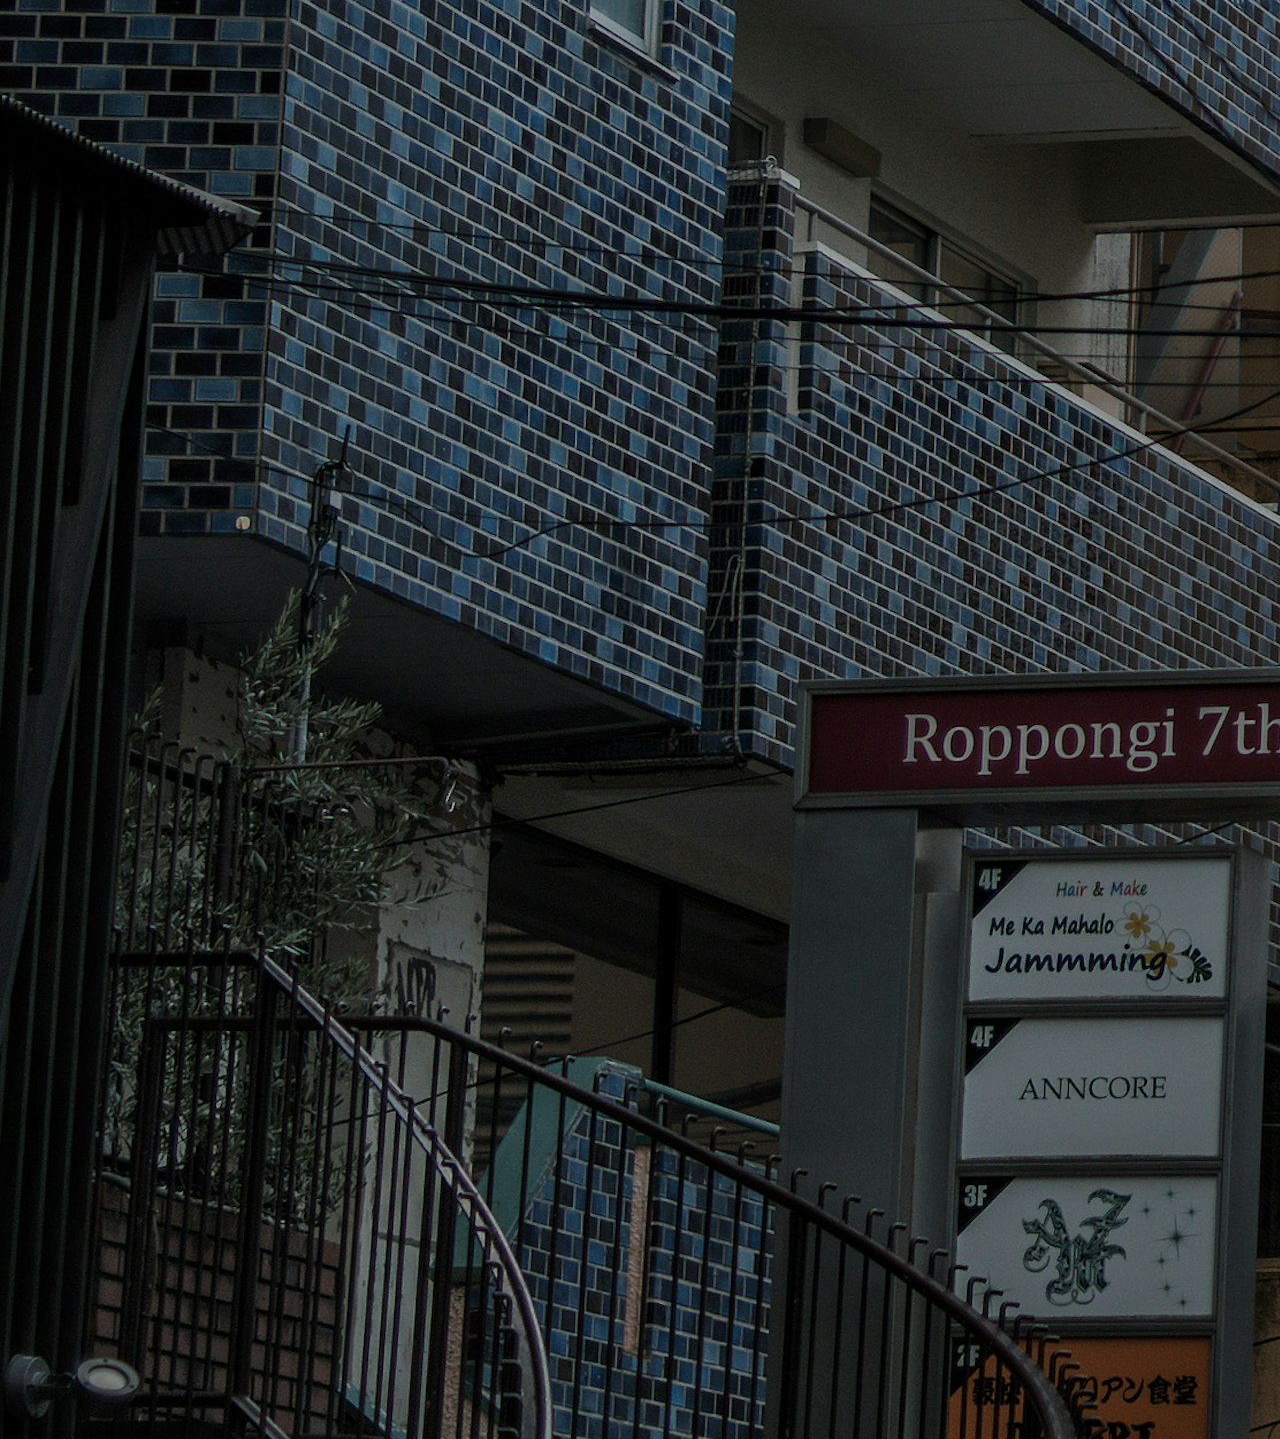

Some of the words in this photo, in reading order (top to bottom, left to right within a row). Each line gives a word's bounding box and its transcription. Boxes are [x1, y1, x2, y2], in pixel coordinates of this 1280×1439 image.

[902, 708, 1176, 776] Roppongi
[978, 868, 1002, 890] 4F
[1056, 881, 1088, 897] Hair
[1093, 882, 1104, 897] &
[1110, 880, 1148, 897] Make
[989, 917, 1014, 936] Me
[1022, 917, 1044, 935] Ka
[1052, 913, 1114, 935] Mahalo
[985, 944, 1168, 981] Jammming
[971, 1025, 994, 1048] 4F
[1019, 1076, 1167, 1101] ANNCORE
[963, 1184, 988, 1207] 3F
